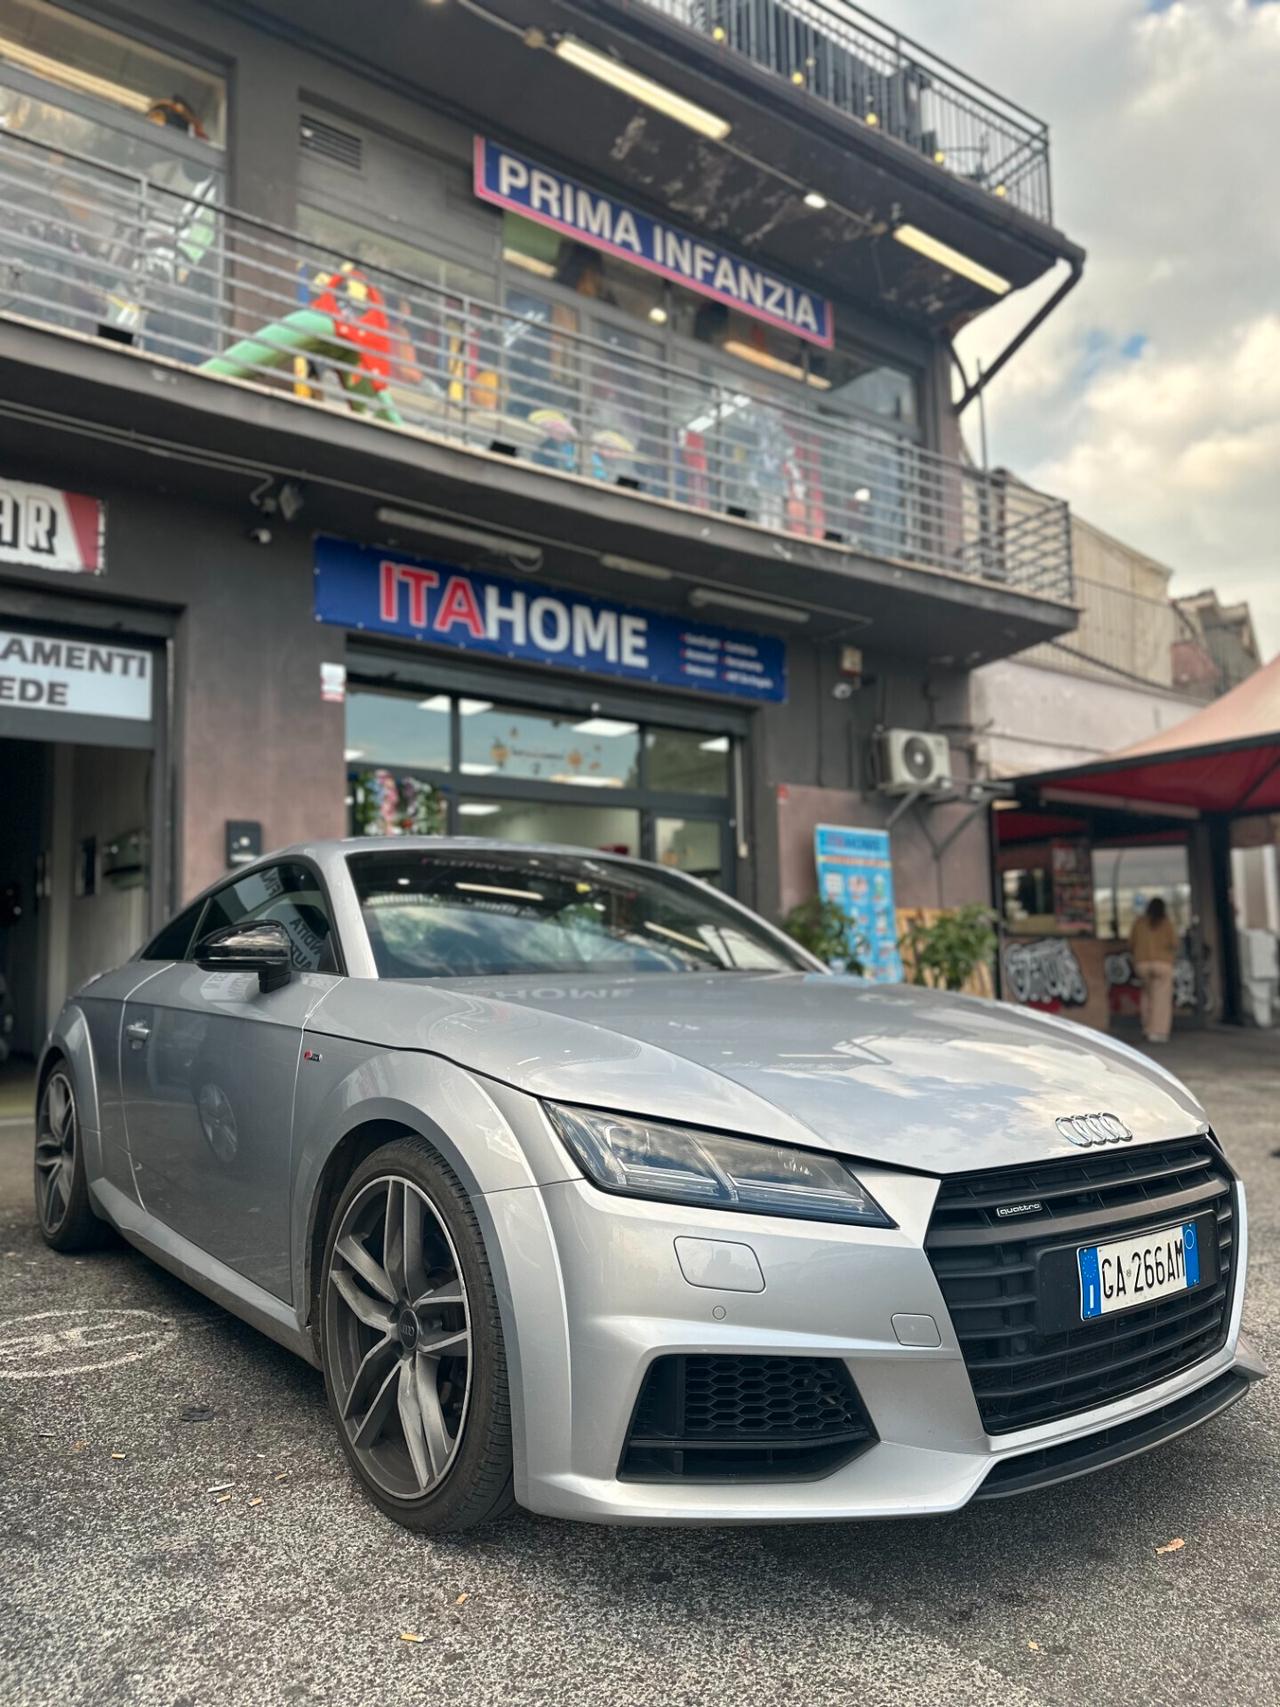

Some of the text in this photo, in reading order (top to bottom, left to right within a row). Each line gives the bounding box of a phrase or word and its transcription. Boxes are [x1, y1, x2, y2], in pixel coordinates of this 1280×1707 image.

[499, 154, 818, 333] PRIMA INFANZIA
[379, 560, 649, 669] ITAHOME
[0, 637, 147, 678] AMENTI
[0, 675, 68, 706] EDE
[1000, 1203, 1040, 1215] quattro
